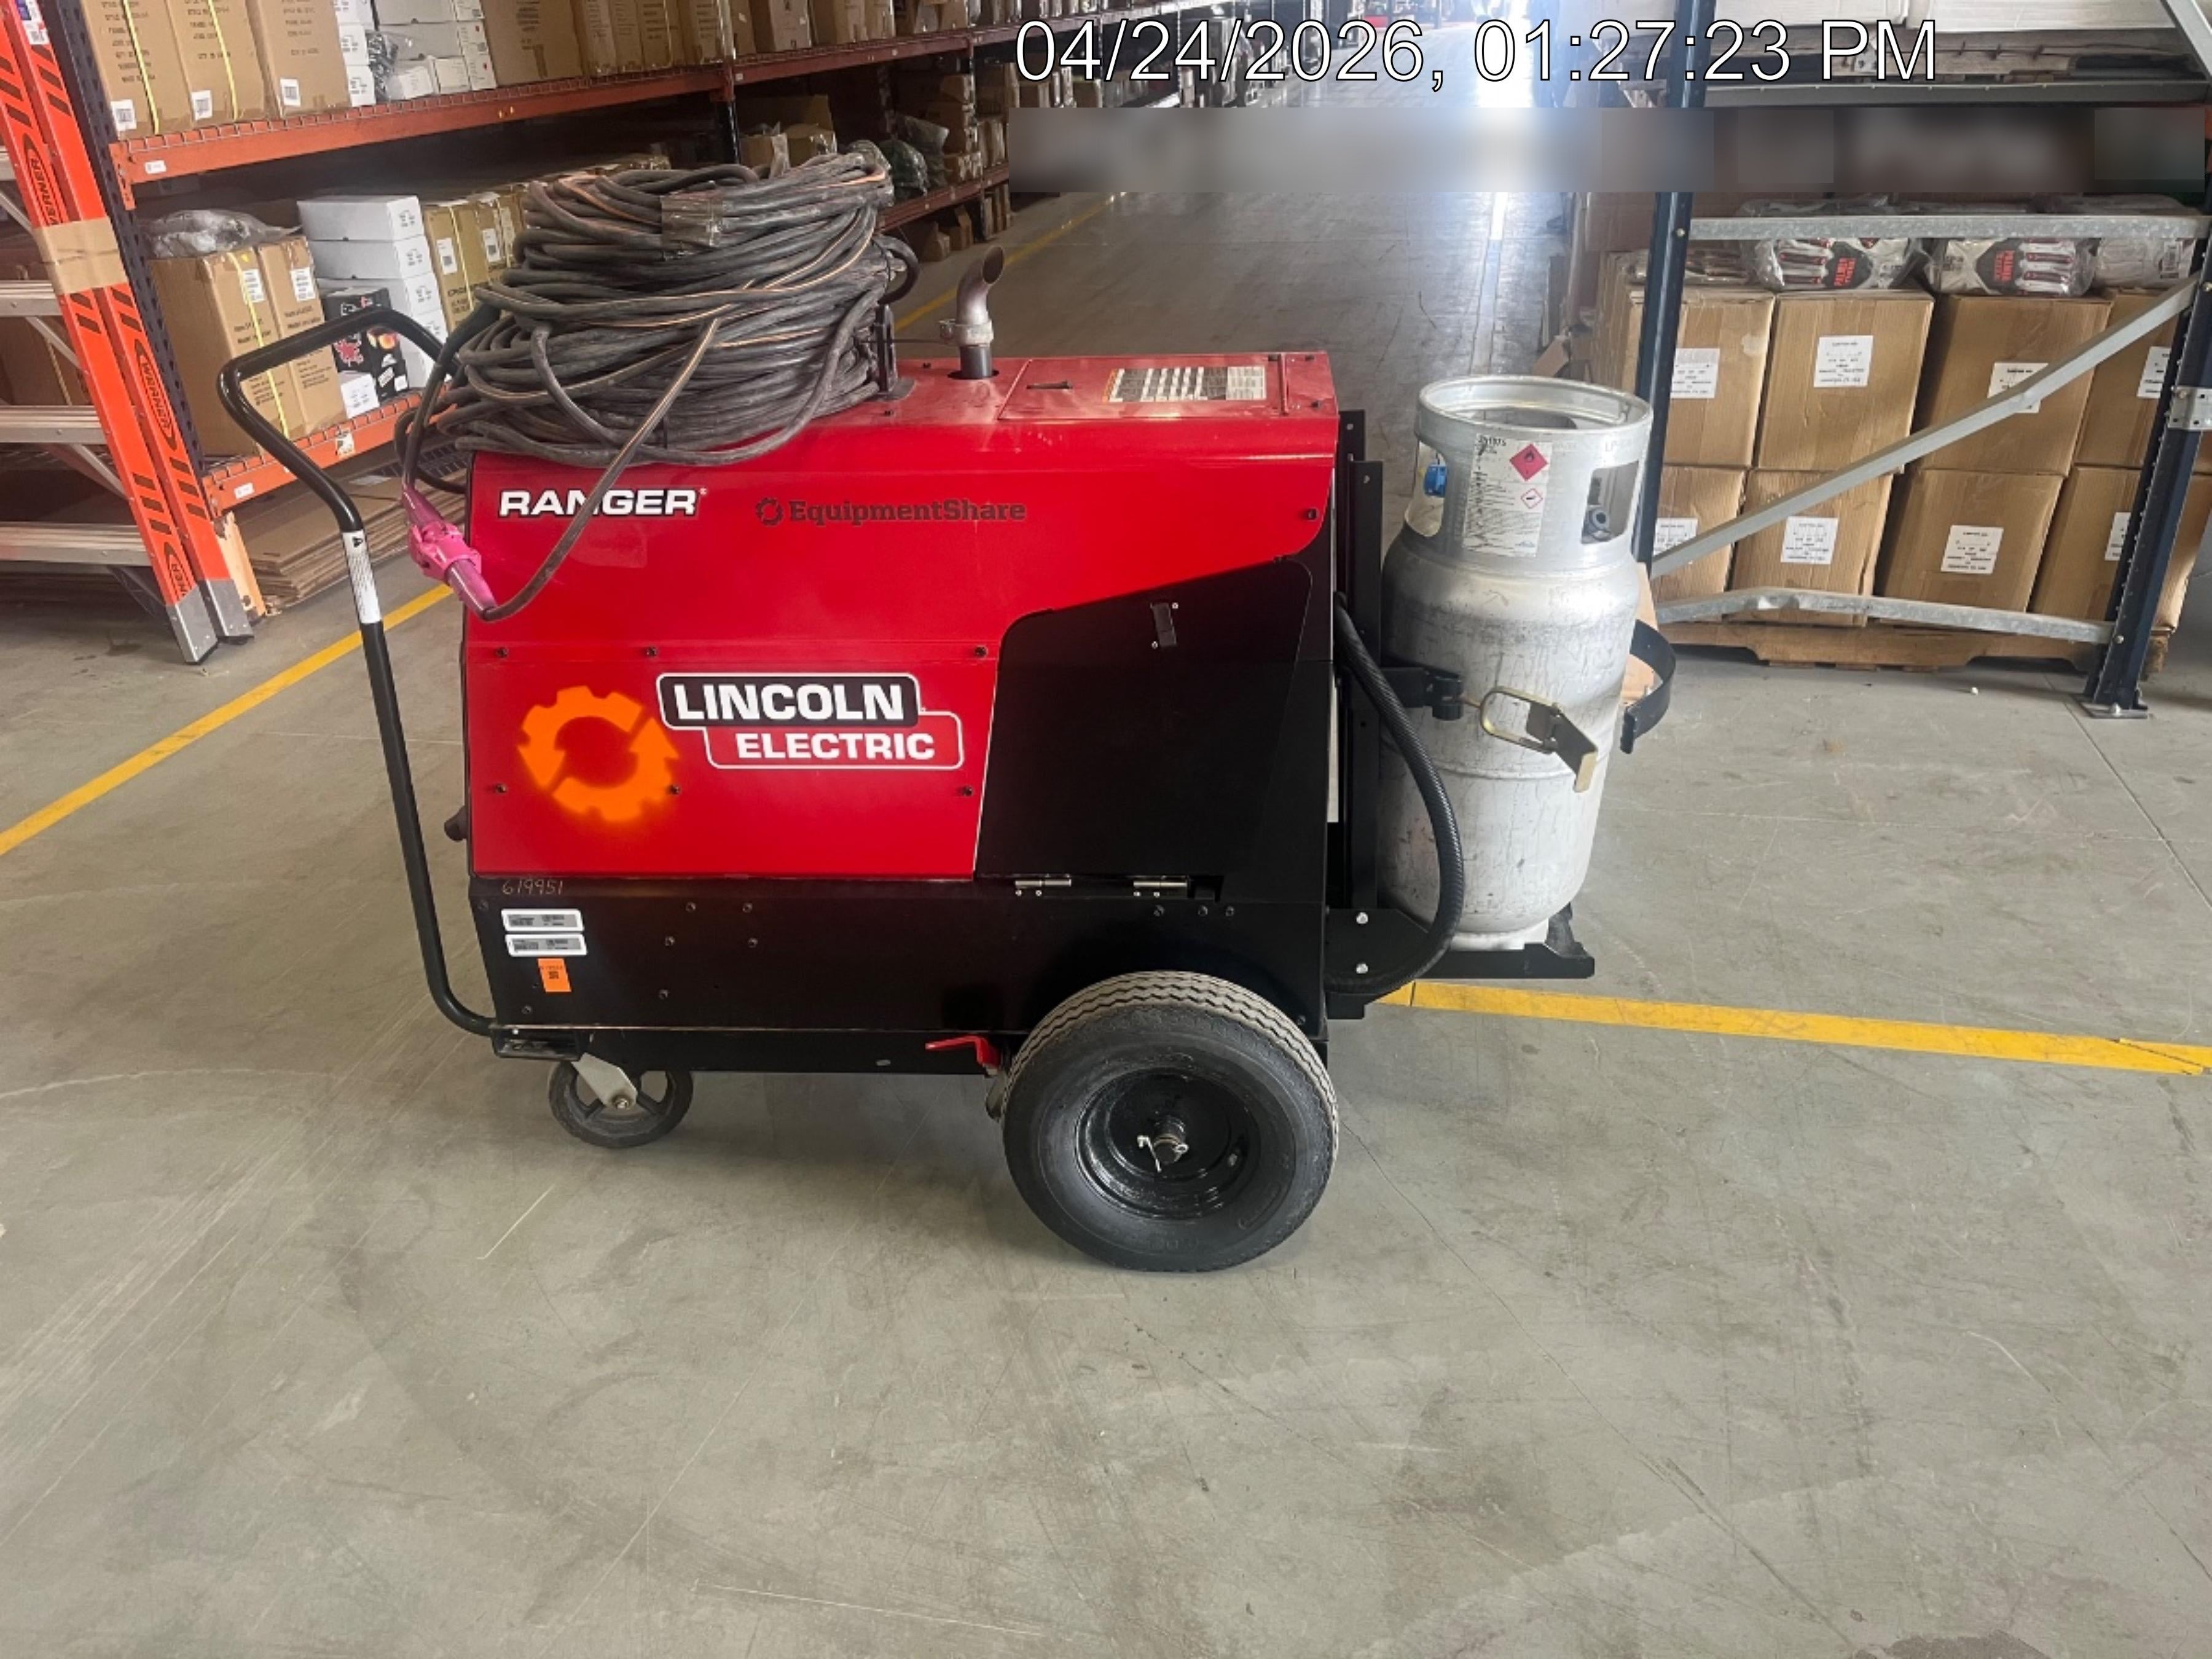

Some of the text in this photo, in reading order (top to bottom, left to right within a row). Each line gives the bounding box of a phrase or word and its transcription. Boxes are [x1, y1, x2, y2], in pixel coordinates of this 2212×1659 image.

[142, 363, 171, 428] WERNER
[789, 499, 1026, 525] EquipmentShare
[673, 684, 904, 721] LINCOLN
[736, 733, 935, 760] ELECTRIC
[502, 879, 563, 895] 619951
